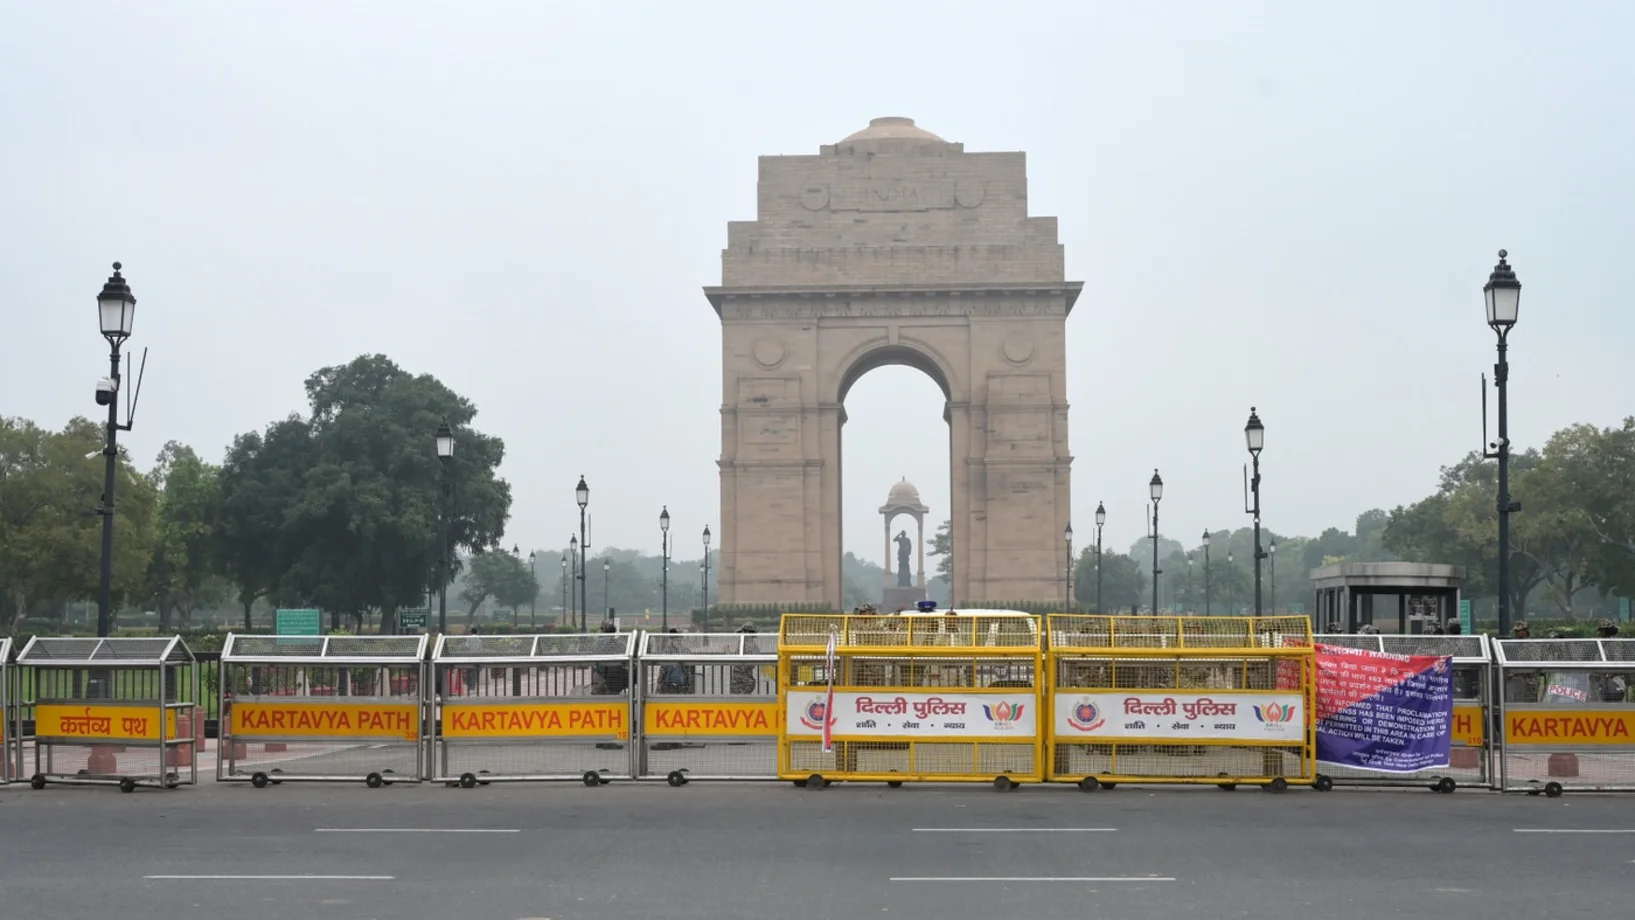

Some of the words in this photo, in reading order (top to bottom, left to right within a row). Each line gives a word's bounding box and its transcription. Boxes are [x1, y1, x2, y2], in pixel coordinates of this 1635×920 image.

[864, 186, 919, 201] INDIA
[1368, 650, 1410, 663] WARNING
[1550, 685, 1586, 701] POLICE
[855, 696, 908, 714] दिल्ली
[912, 697, 967, 719] पुलिस
[1123, 697, 1178, 715] दिल्ली
[1182, 698, 1237, 720] पुलिस
[1359, 710, 1374, 718] HAS
[1376, 712, 1395, 720] BEEN
[1376, 704, 1393, 712] THAT
[1397, 707, 1448, 718] PROCLAMATION
[122, 717, 148, 736] पथ
[241, 709, 351, 729] KARTAVYA
[358, 711, 410, 730] PATH
[452, 710, 562, 730] KARTAVYA
[569, 709, 622, 729] PATH
[655, 709, 769, 729] KARTAVYA
[902, 720, 920, 729] सेवा
[1172, 721, 1189, 730] सेवा
[1378, 720, 1435, 732] DEMONSTRATION
[1512, 717, 1629, 737] KARTAVYA
[1354, 732, 1371, 741] WILL
[1390, 730, 1408, 738] AREA
[1417, 732, 1435, 740] CASE
